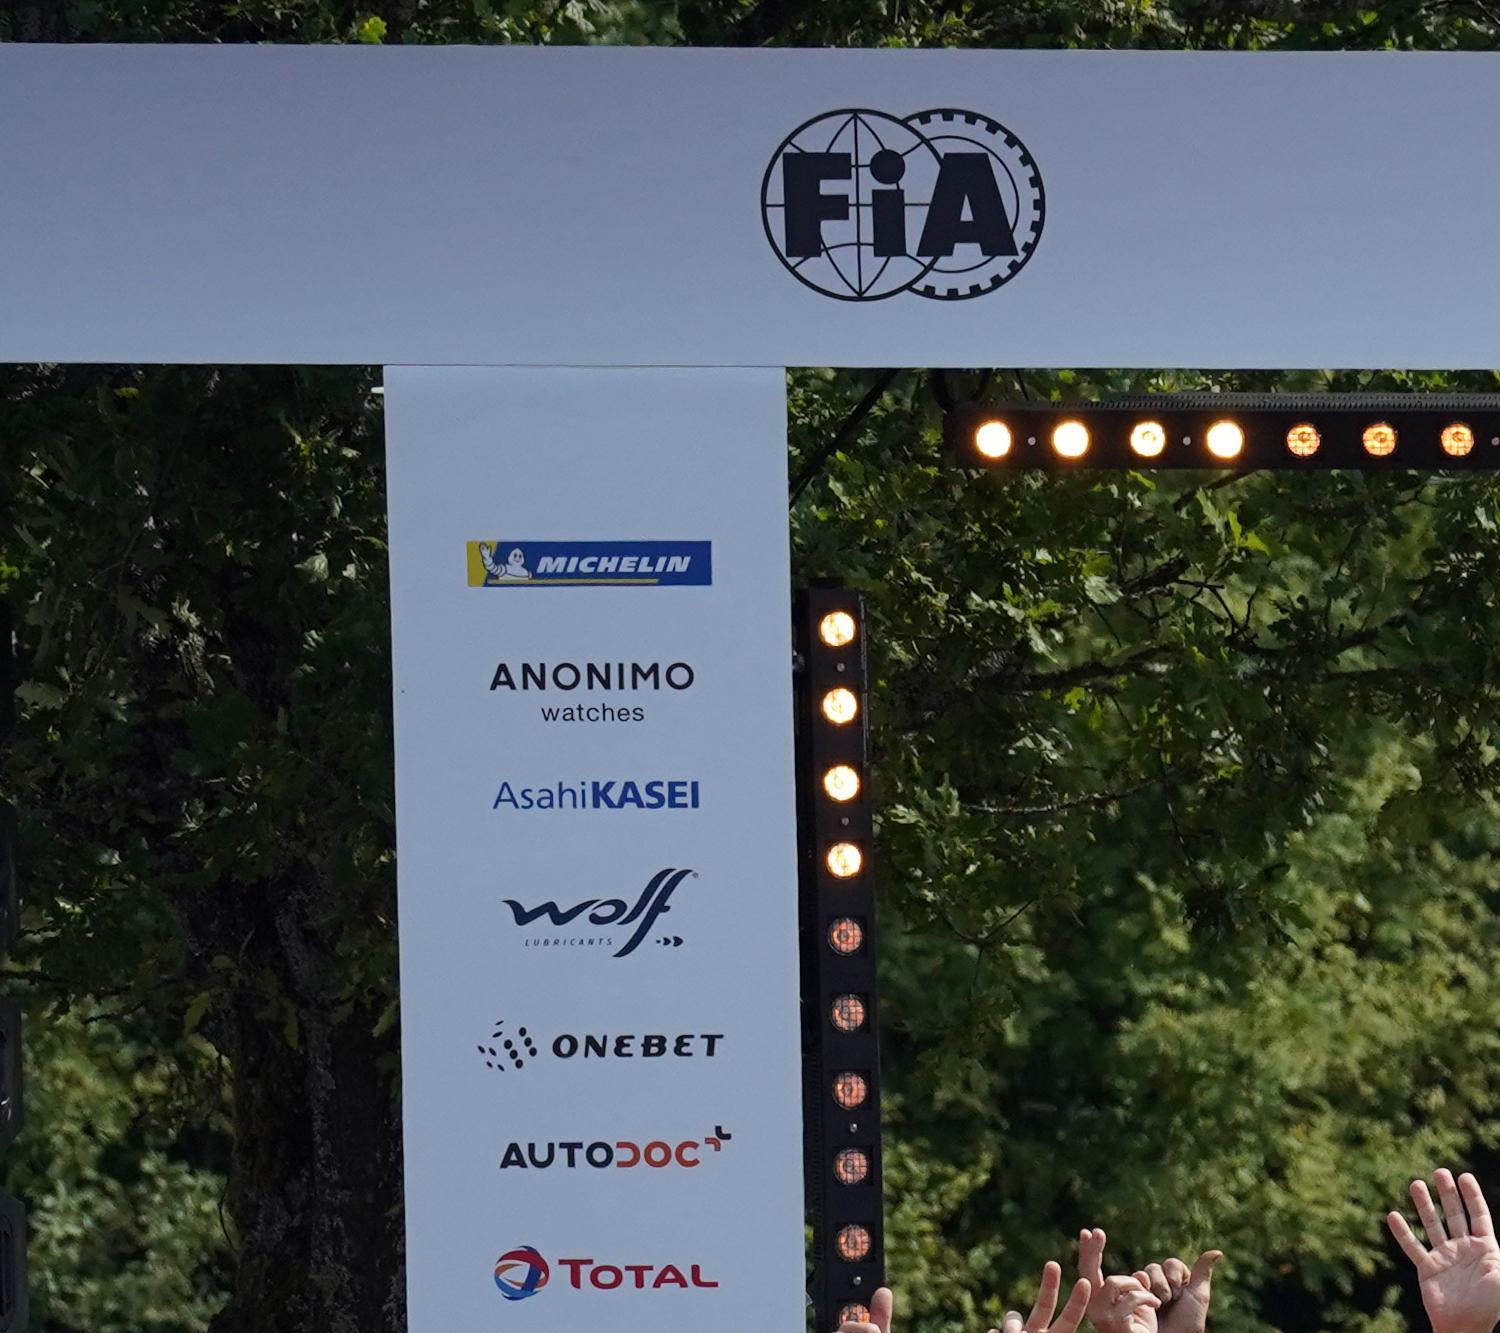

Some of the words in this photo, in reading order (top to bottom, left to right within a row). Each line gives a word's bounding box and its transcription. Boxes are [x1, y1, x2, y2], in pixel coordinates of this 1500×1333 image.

[536, 554, 691, 574] MICHELIN
[490, 661, 696, 693] ANONIMO
[541, 701, 646, 724] watches
[492, 779, 700, 811] AsahiKASEI
[524, 936, 615, 948] LUBRICANTS
[551, 1032, 724, 1059] ONEBET
[499, 1140, 701, 1170] AUTODOC
[557, 1258, 719, 1290] TOTAL
